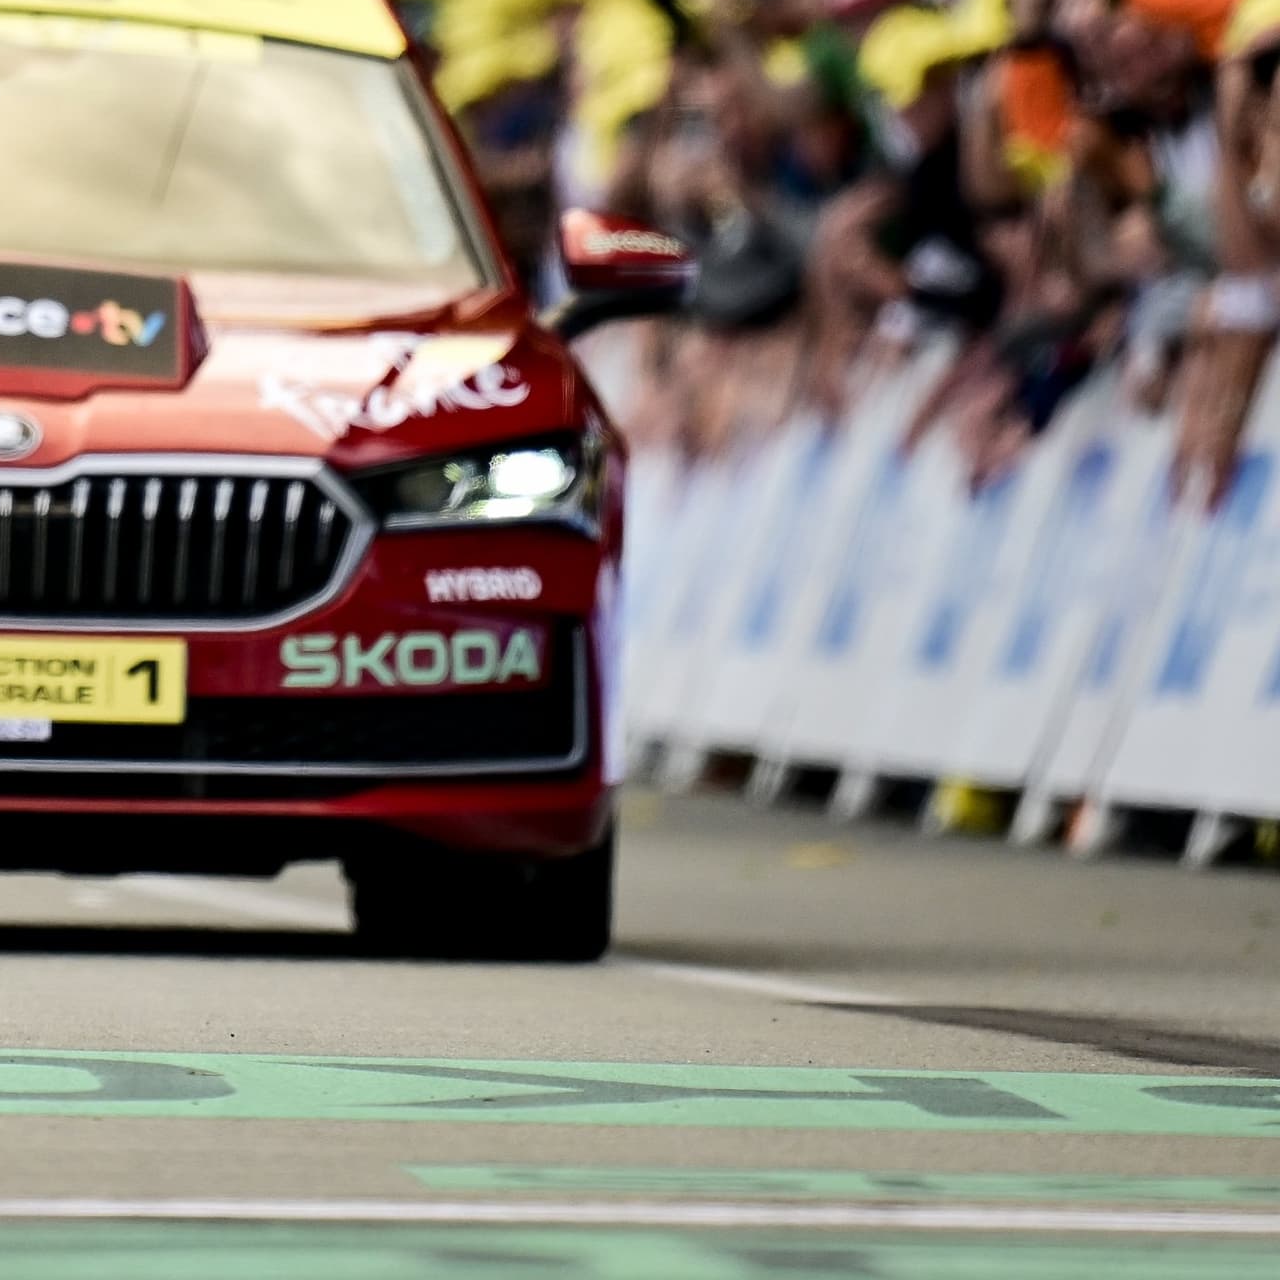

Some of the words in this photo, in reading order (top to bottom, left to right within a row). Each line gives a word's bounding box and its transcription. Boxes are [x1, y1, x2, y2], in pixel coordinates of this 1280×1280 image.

[425, 567, 543, 602] HYBRID
[125, 659, 160, 705] 1
[280, 631, 541, 688] SKODA
